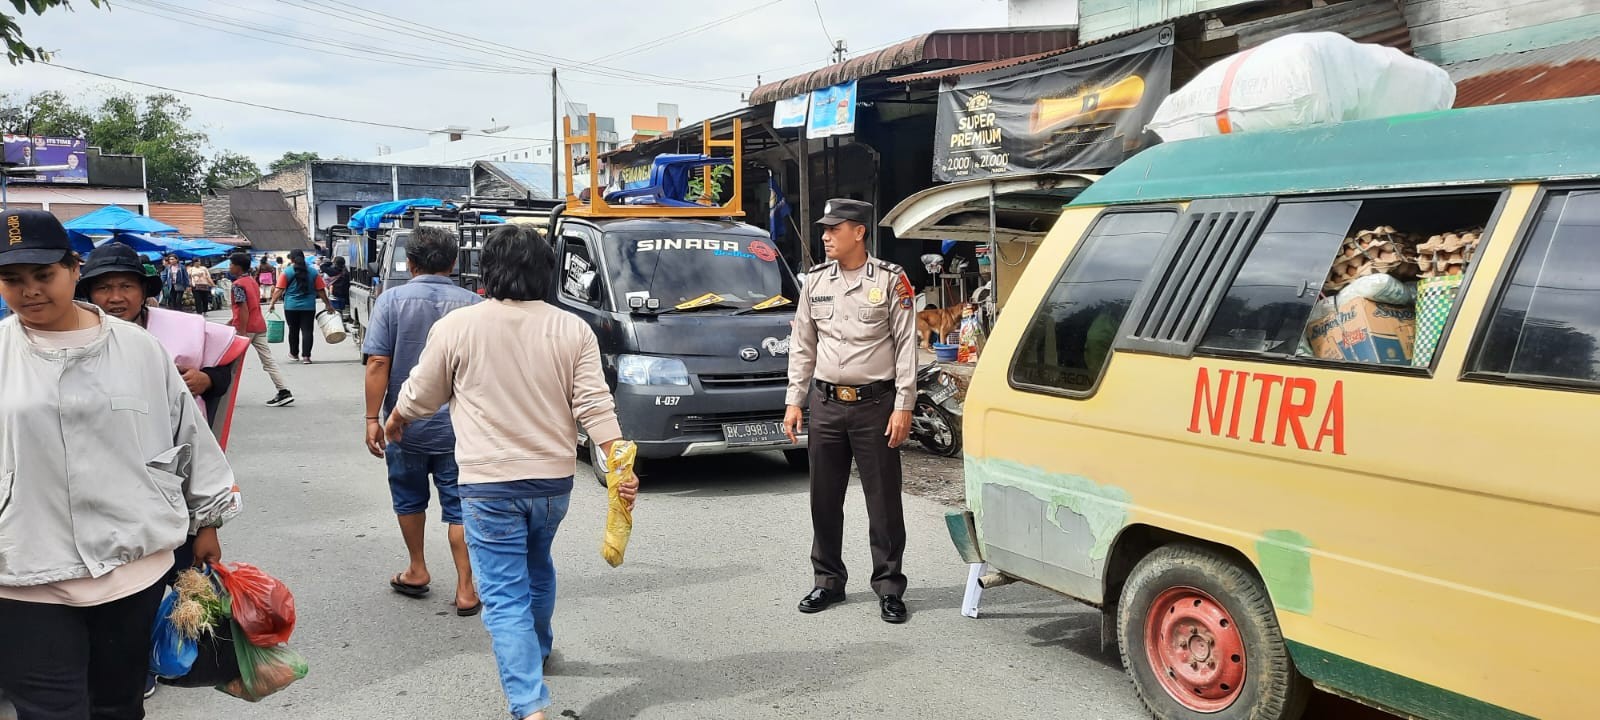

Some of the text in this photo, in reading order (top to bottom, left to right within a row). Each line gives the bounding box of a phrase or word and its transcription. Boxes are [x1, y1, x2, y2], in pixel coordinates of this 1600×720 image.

[958, 112, 996, 130] SUPER
[950, 127, 1002, 148] PREMIUM
[636, 238, 739, 252] SINAGA
[655, 395, 681, 406] K-037
[1187, 366, 1347, 456] NITRA
[745, 424, 769, 436] 9983
